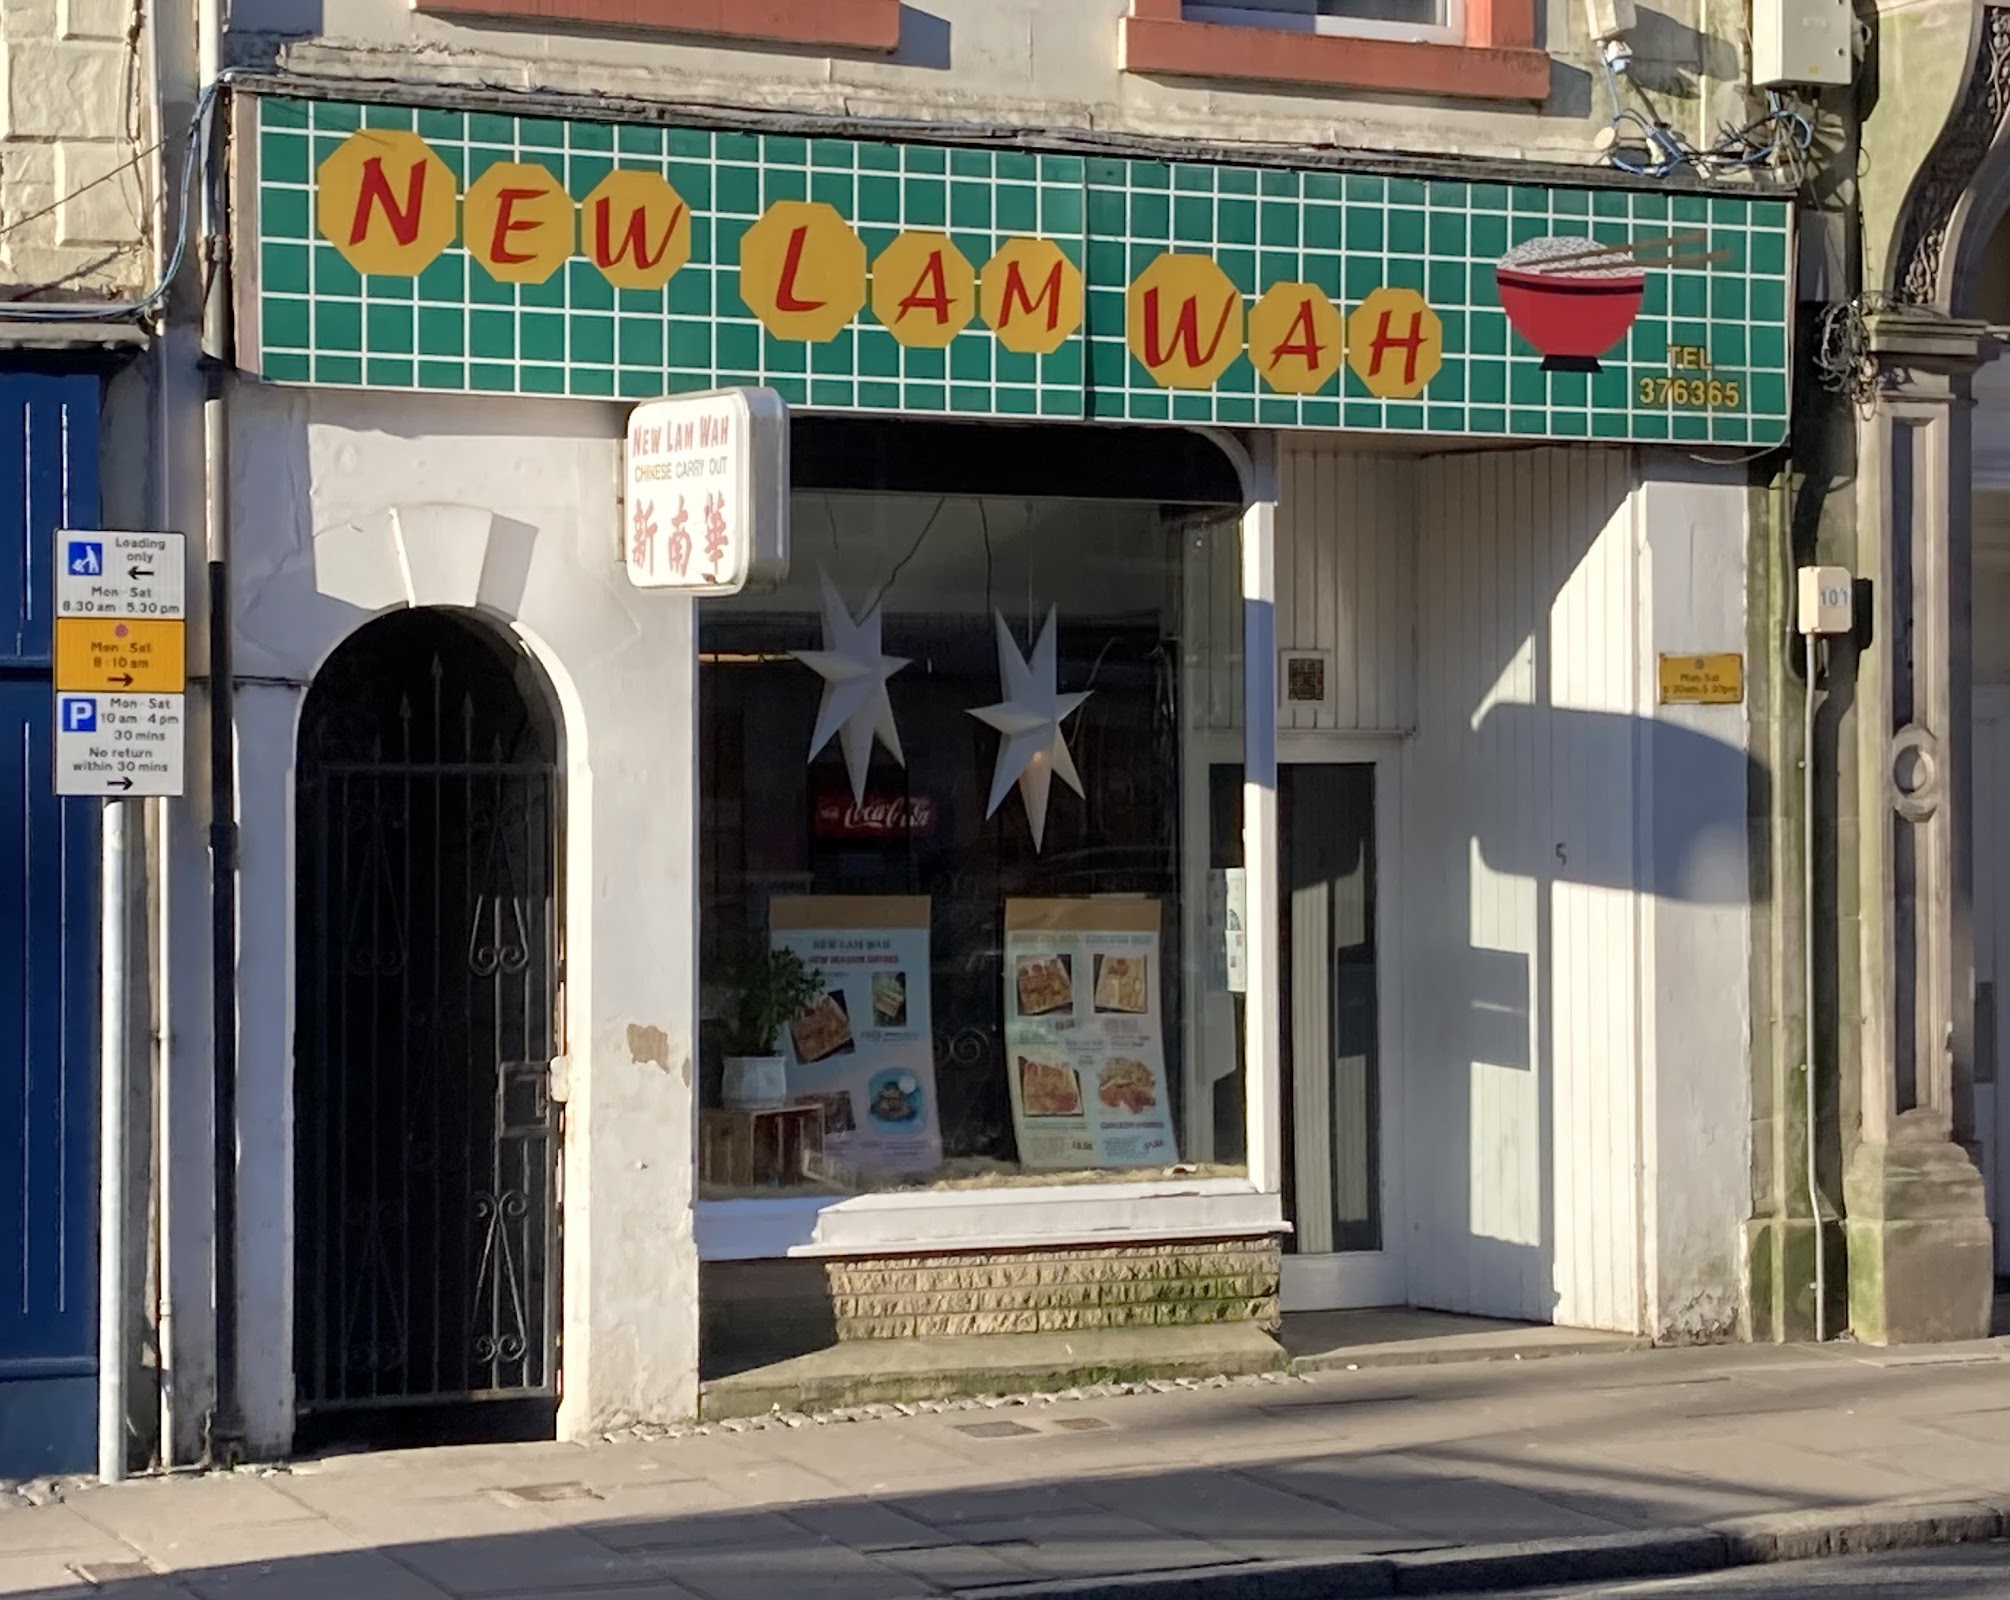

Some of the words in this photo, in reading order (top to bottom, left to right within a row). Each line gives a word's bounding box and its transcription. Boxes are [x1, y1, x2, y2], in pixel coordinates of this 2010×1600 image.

[348, 156, 684, 270] NEW
[774, 225, 1064, 333] LAM
[1141, 287, 1428, 385] WAH
[1667, 345, 1712, 370] TEL
[1639, 377, 1740, 408] 376365
[632, 424, 662, 458] NEW
[666, 419, 694, 453] LAM
[699, 414, 729, 448] WAH
[634, 462, 672, 484] CHINESE
[675, 459, 705, 479] CARRY
[709, 456, 728, 476] OUT
[115, 537, 166, 550] Loading
[126, 551, 154, 564] only
[91, 586, 119, 598] Mon
[129, 587, 152, 598] Sat
[1821, 588, 1849, 606] 101
[160, 604, 180, 615] pm
[110, 698, 137, 709] Mon
[148, 698, 171, 709] Sat
[70, 701, 93, 730] P
[159, 715, 179, 726] pm
[114, 730, 133, 741] 30
[135, 731, 166, 741] mins
[89, 747, 108, 758] No
[112, 747, 153, 758] return
[73, 760, 113, 771] within
[117, 761, 135, 772] 30
[138, 761, 168, 772] mins
